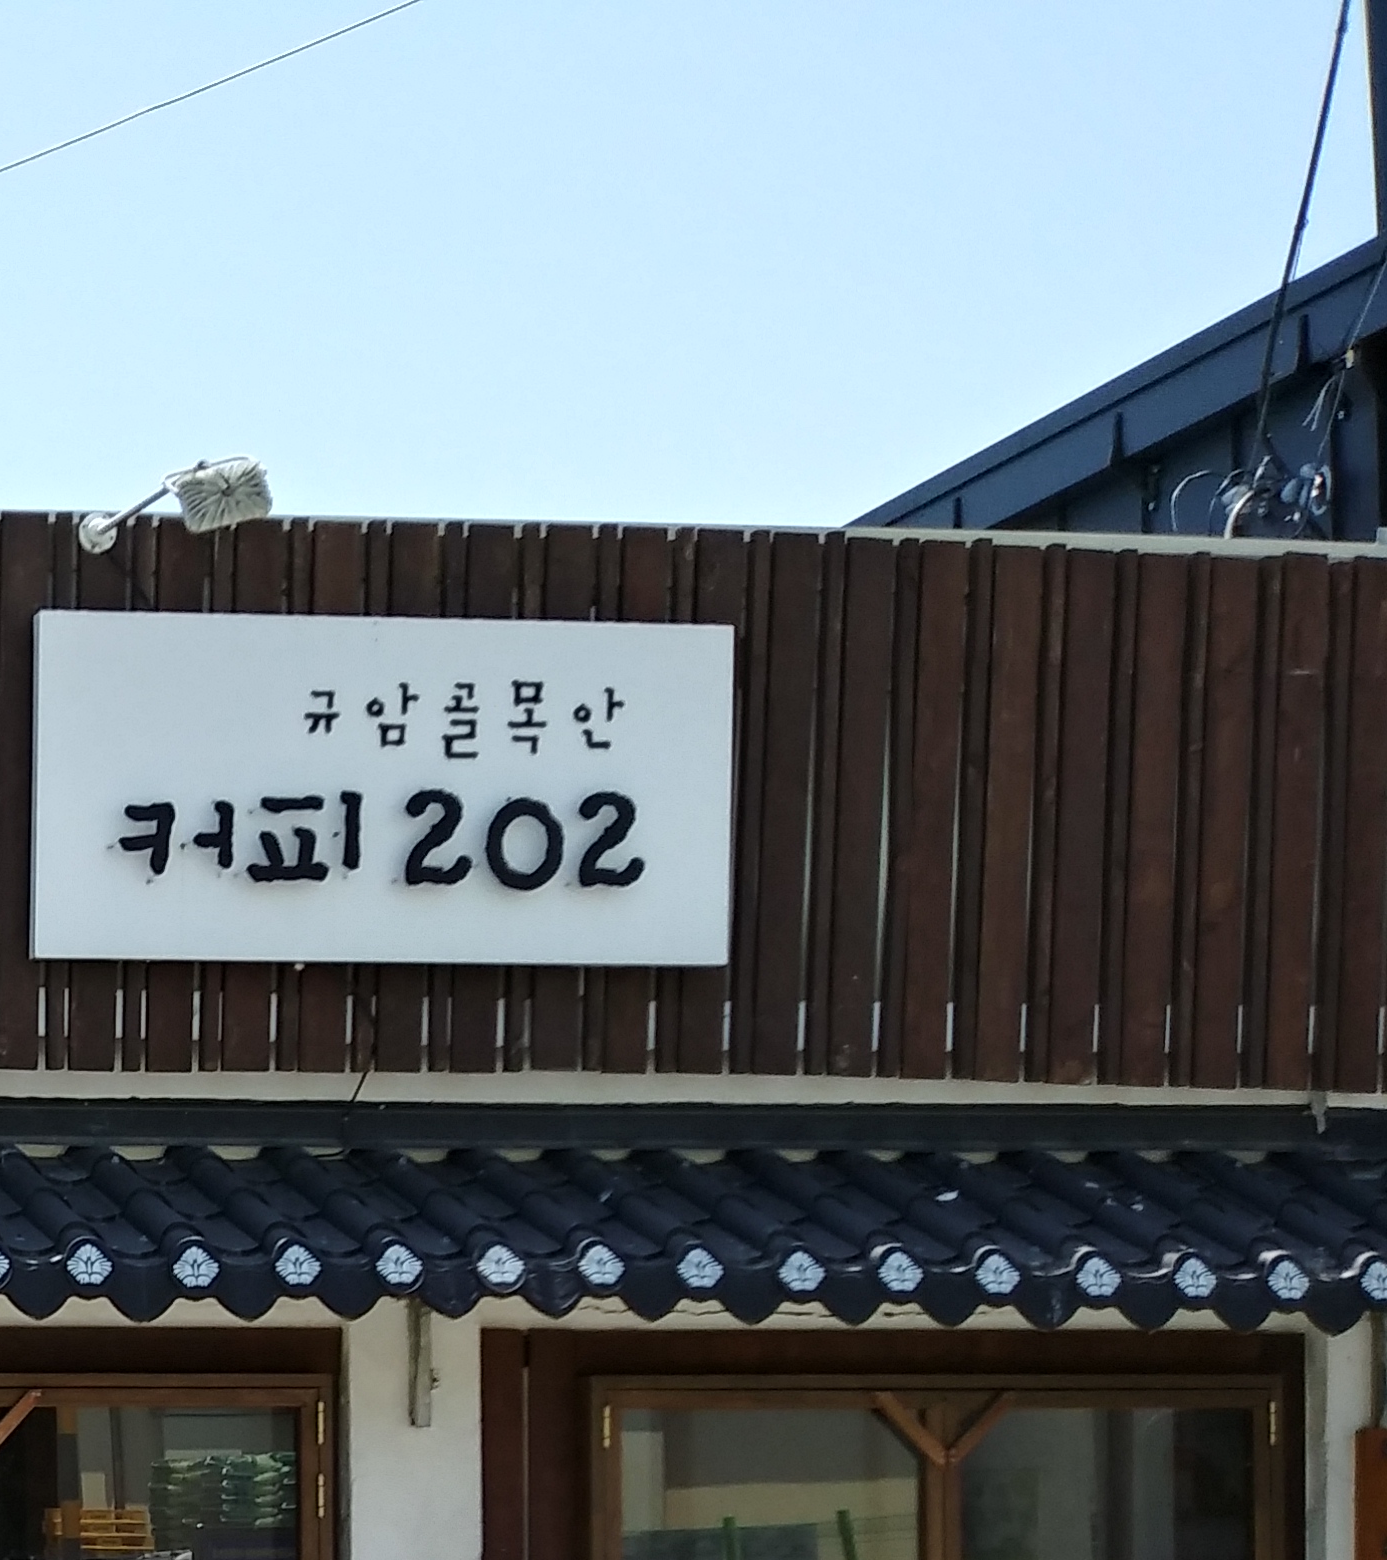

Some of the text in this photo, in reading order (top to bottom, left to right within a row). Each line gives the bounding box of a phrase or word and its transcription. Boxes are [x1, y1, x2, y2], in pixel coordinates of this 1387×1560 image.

[303, 679, 626, 760] 규암골목안
[117, 788, 647, 893] 커피 202
